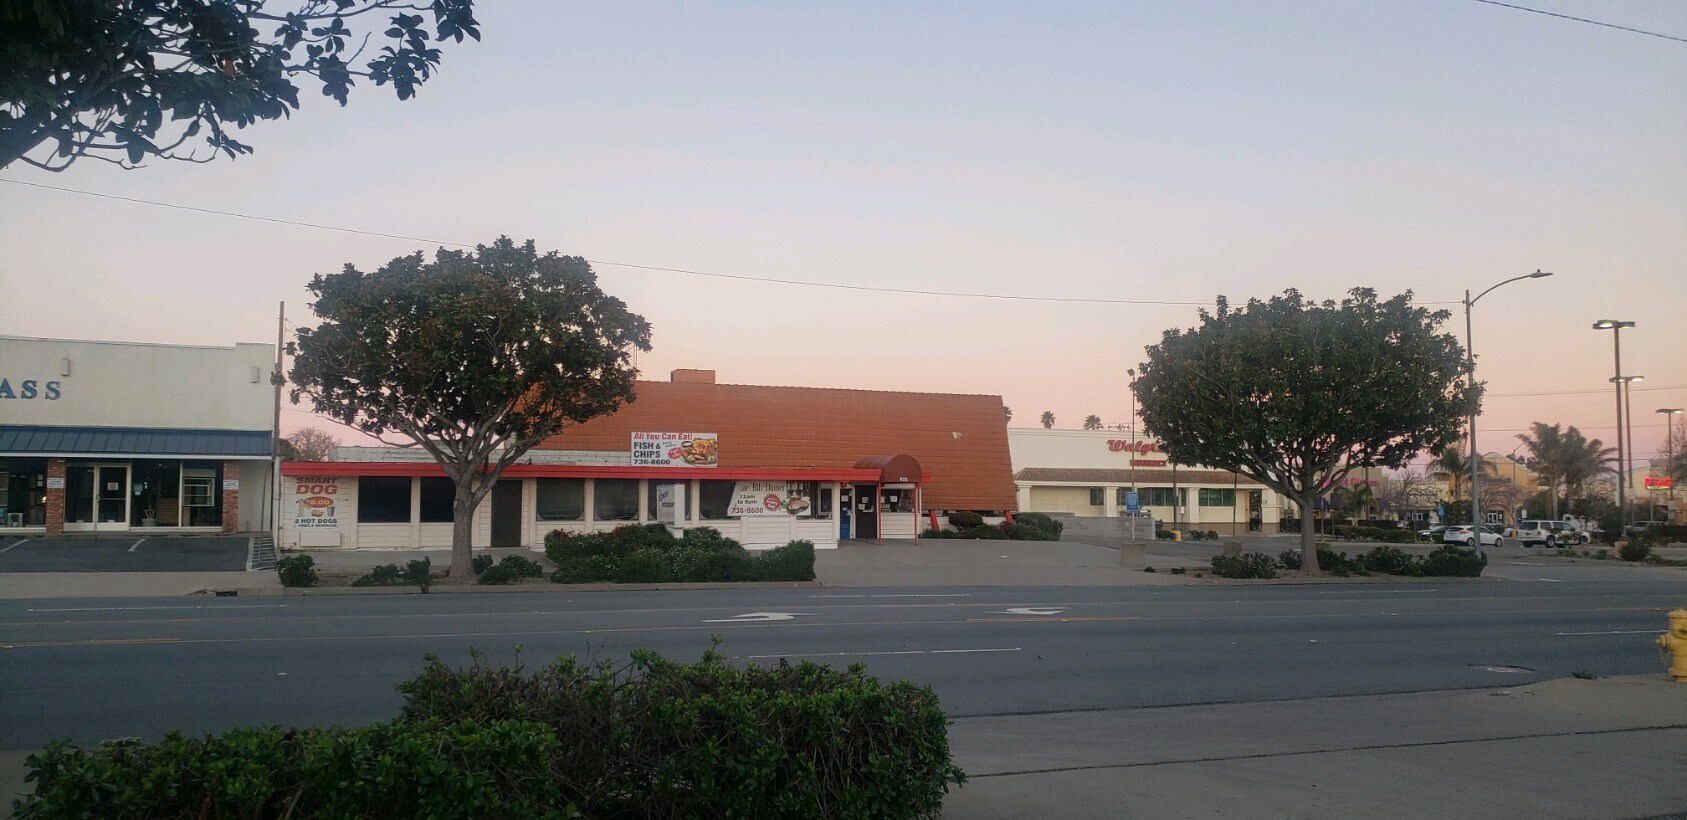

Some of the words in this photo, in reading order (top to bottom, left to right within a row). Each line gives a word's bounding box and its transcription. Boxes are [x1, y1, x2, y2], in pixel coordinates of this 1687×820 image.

[0, 378, 61, 400] ASS
[633, 432, 644, 440] All
[646, 432, 660, 440] You
[661, 432, 676, 440] Can
[678, 432, 693, 441] Eat!
[633, 442, 654, 450] FISH
[1107, 439, 1164, 456] Walgr
[633, 450, 661, 459] CHIPS
[296, 476, 338, 484] SMART
[296, 484, 338, 495] DOG
